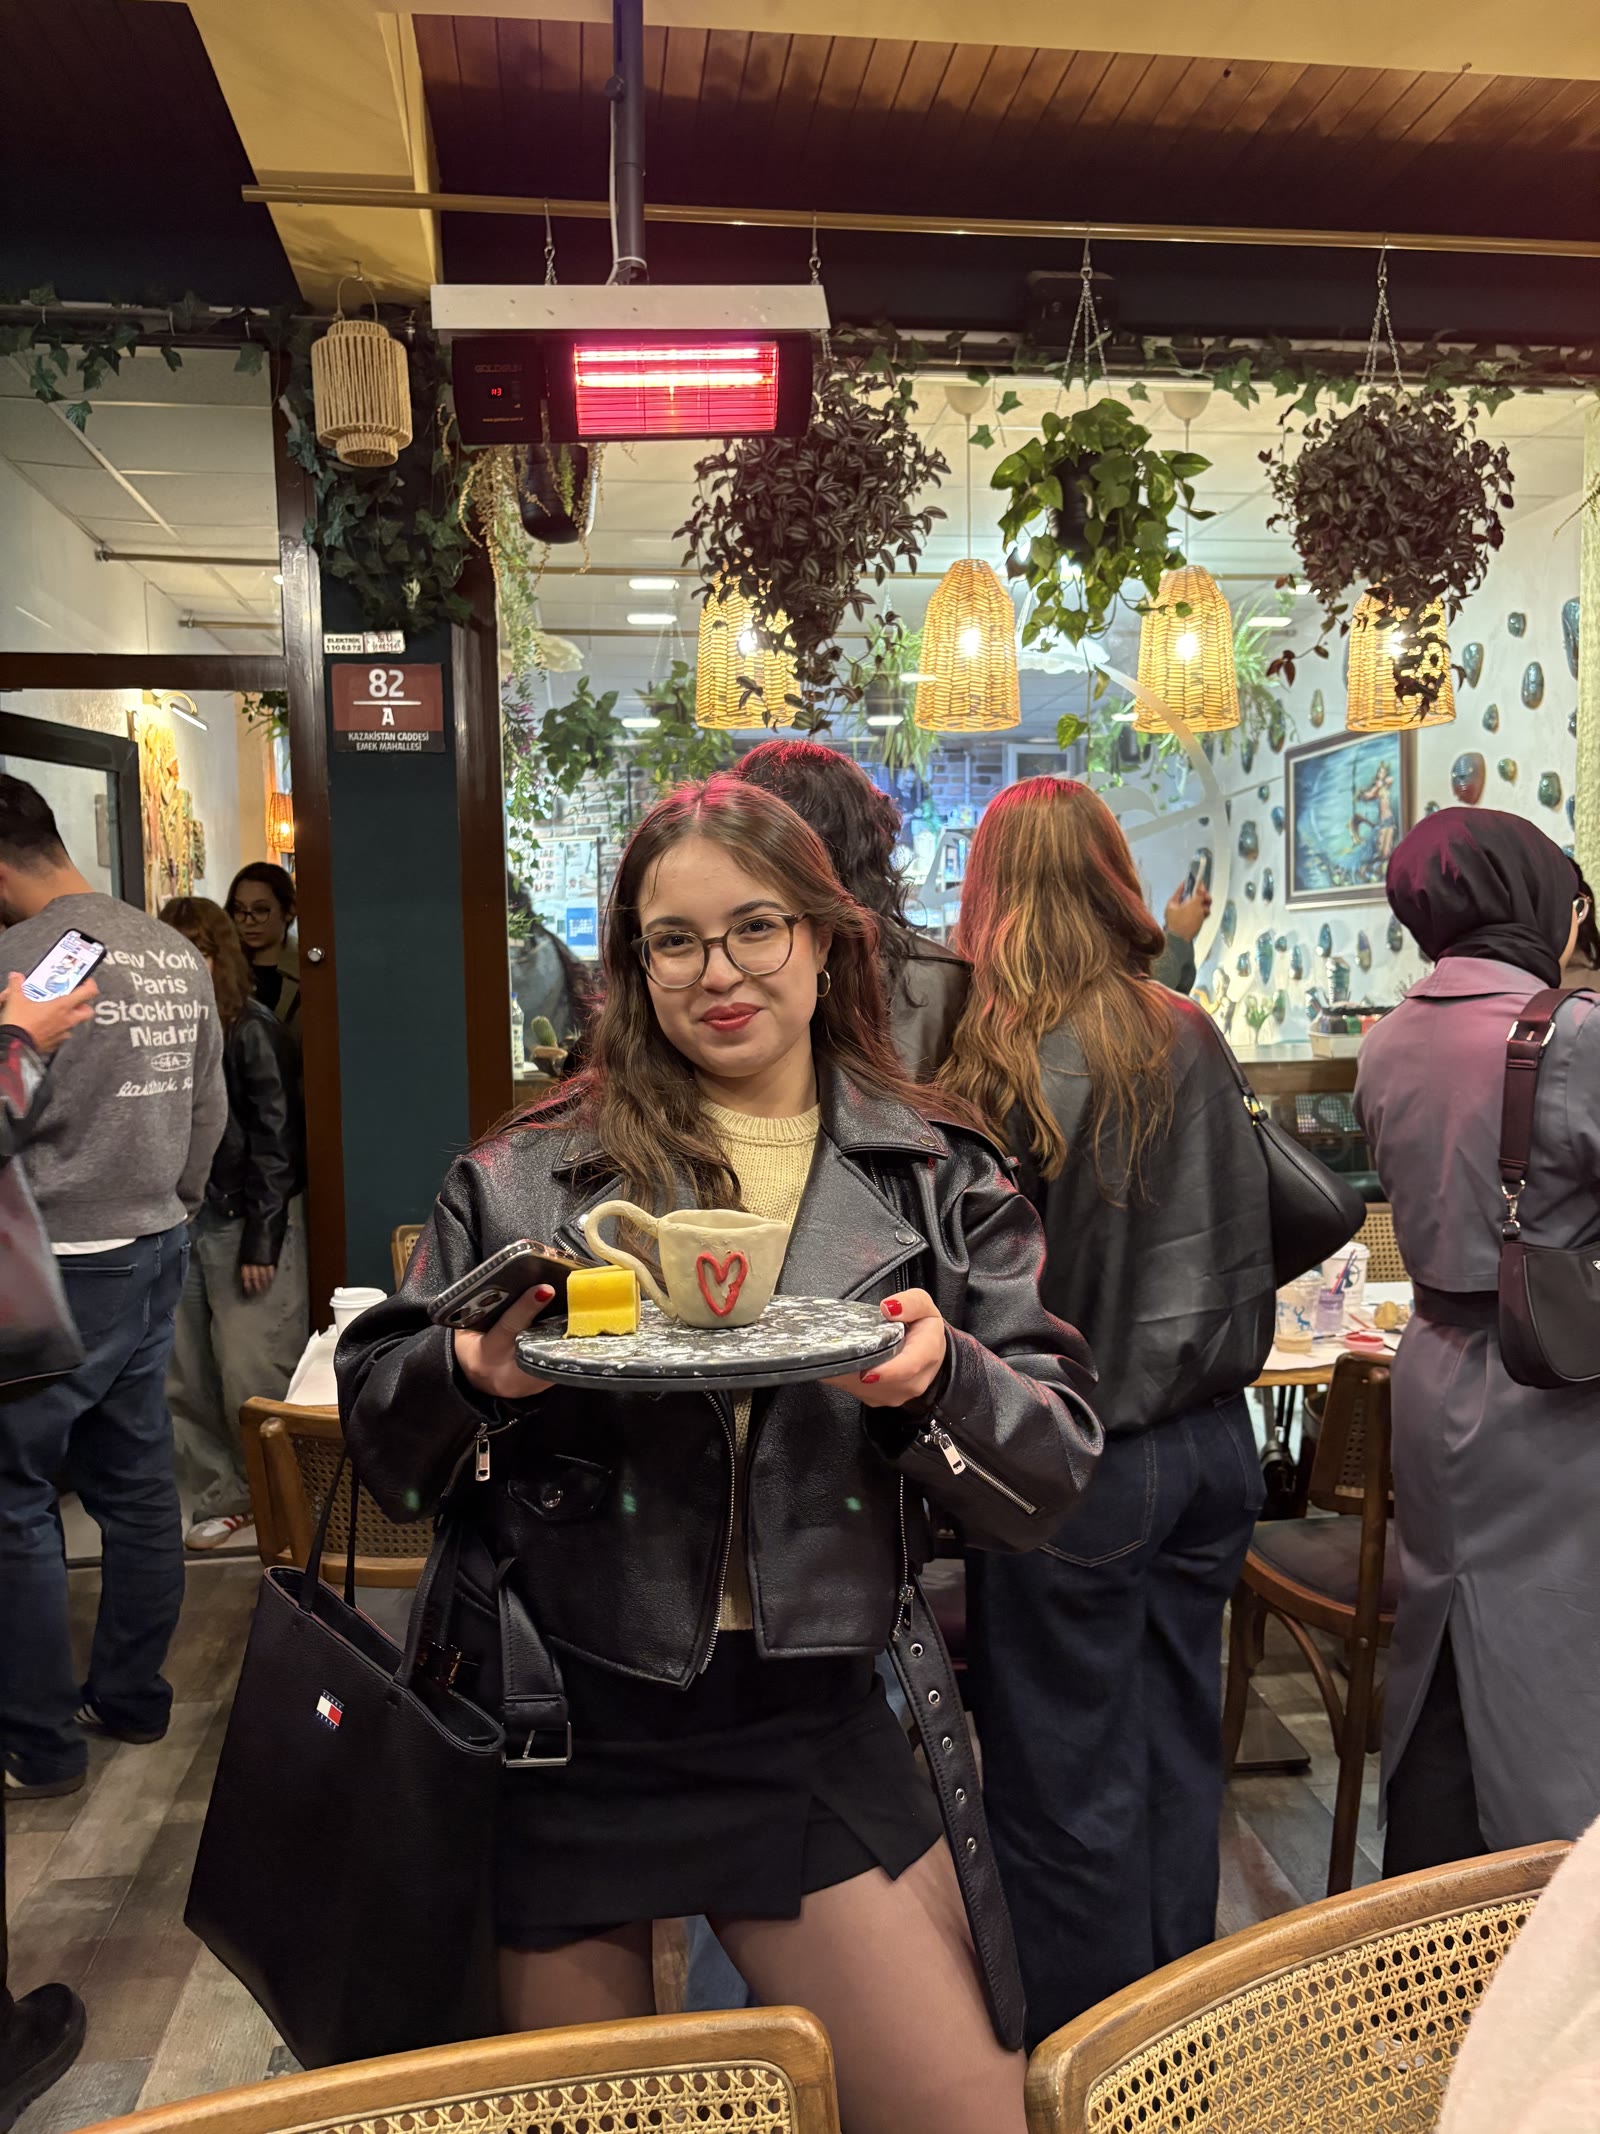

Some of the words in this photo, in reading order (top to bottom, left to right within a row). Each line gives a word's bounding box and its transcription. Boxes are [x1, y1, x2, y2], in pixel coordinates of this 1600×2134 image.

[369, 669, 404, 697] 82
[382, 707, 395, 726] A
[348, 731, 396, 741] KAZAKİSTAN
[397, 731, 429, 741] CADDESİ
[356, 741, 378, 751] EMEK
[379, 741, 422, 751] MAHALLESİ
[147, 949, 199, 970] York
[131, 971, 188, 994] Paris
